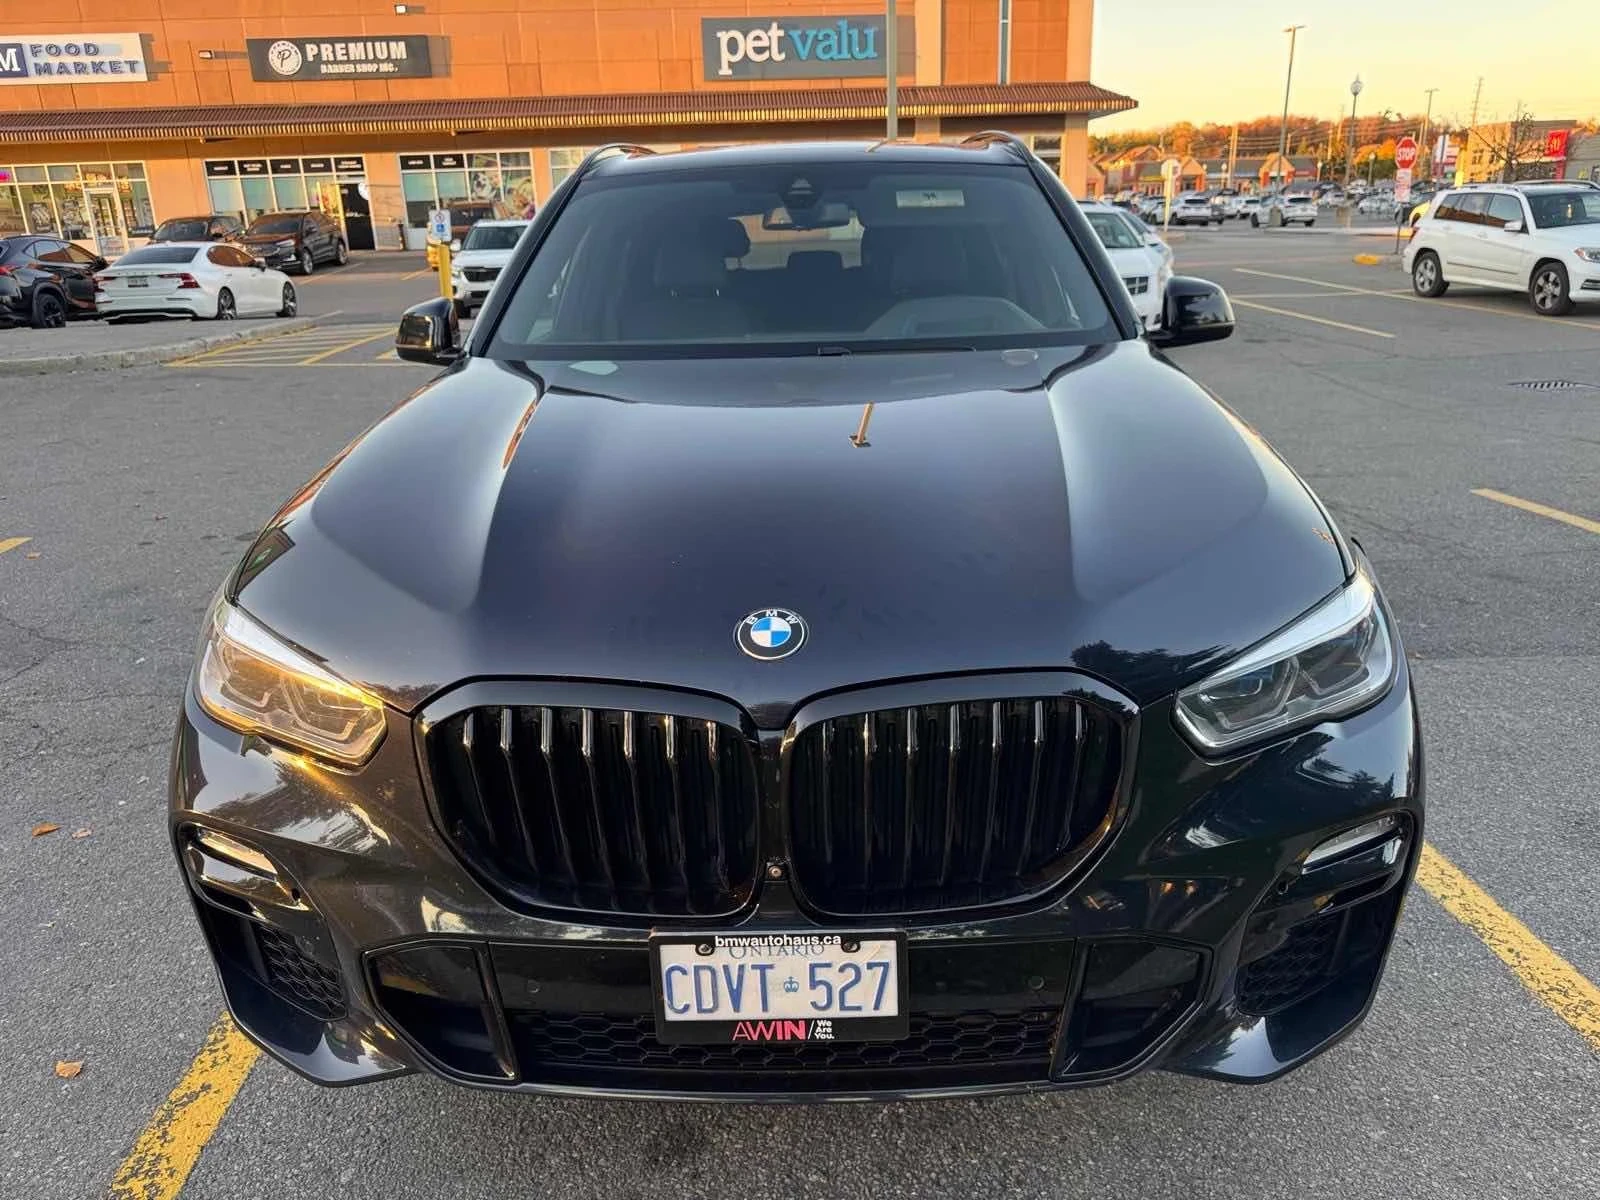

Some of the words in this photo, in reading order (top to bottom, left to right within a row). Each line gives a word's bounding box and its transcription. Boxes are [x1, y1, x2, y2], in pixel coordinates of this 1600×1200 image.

[30, 43, 100, 57] FOOD
[304, 41, 408, 62] PREMIUM
[716, 22, 786, 75] pet
[788, 19, 879, 60] valu
[33, 60, 139, 76] MARKET
[1397, 146, 1416, 161] STOP
[745, 608, 800, 625] BMW
[714, 934, 842, 947] bmwautohaus.ca
[728, 945, 825, 960] ONTARIO
[664, 963, 775, 1014] CDVT
[808, 961, 891, 1012] 527
[732, 1020, 807, 1041] AWIN
[815, 1026, 833, 1034] Are
